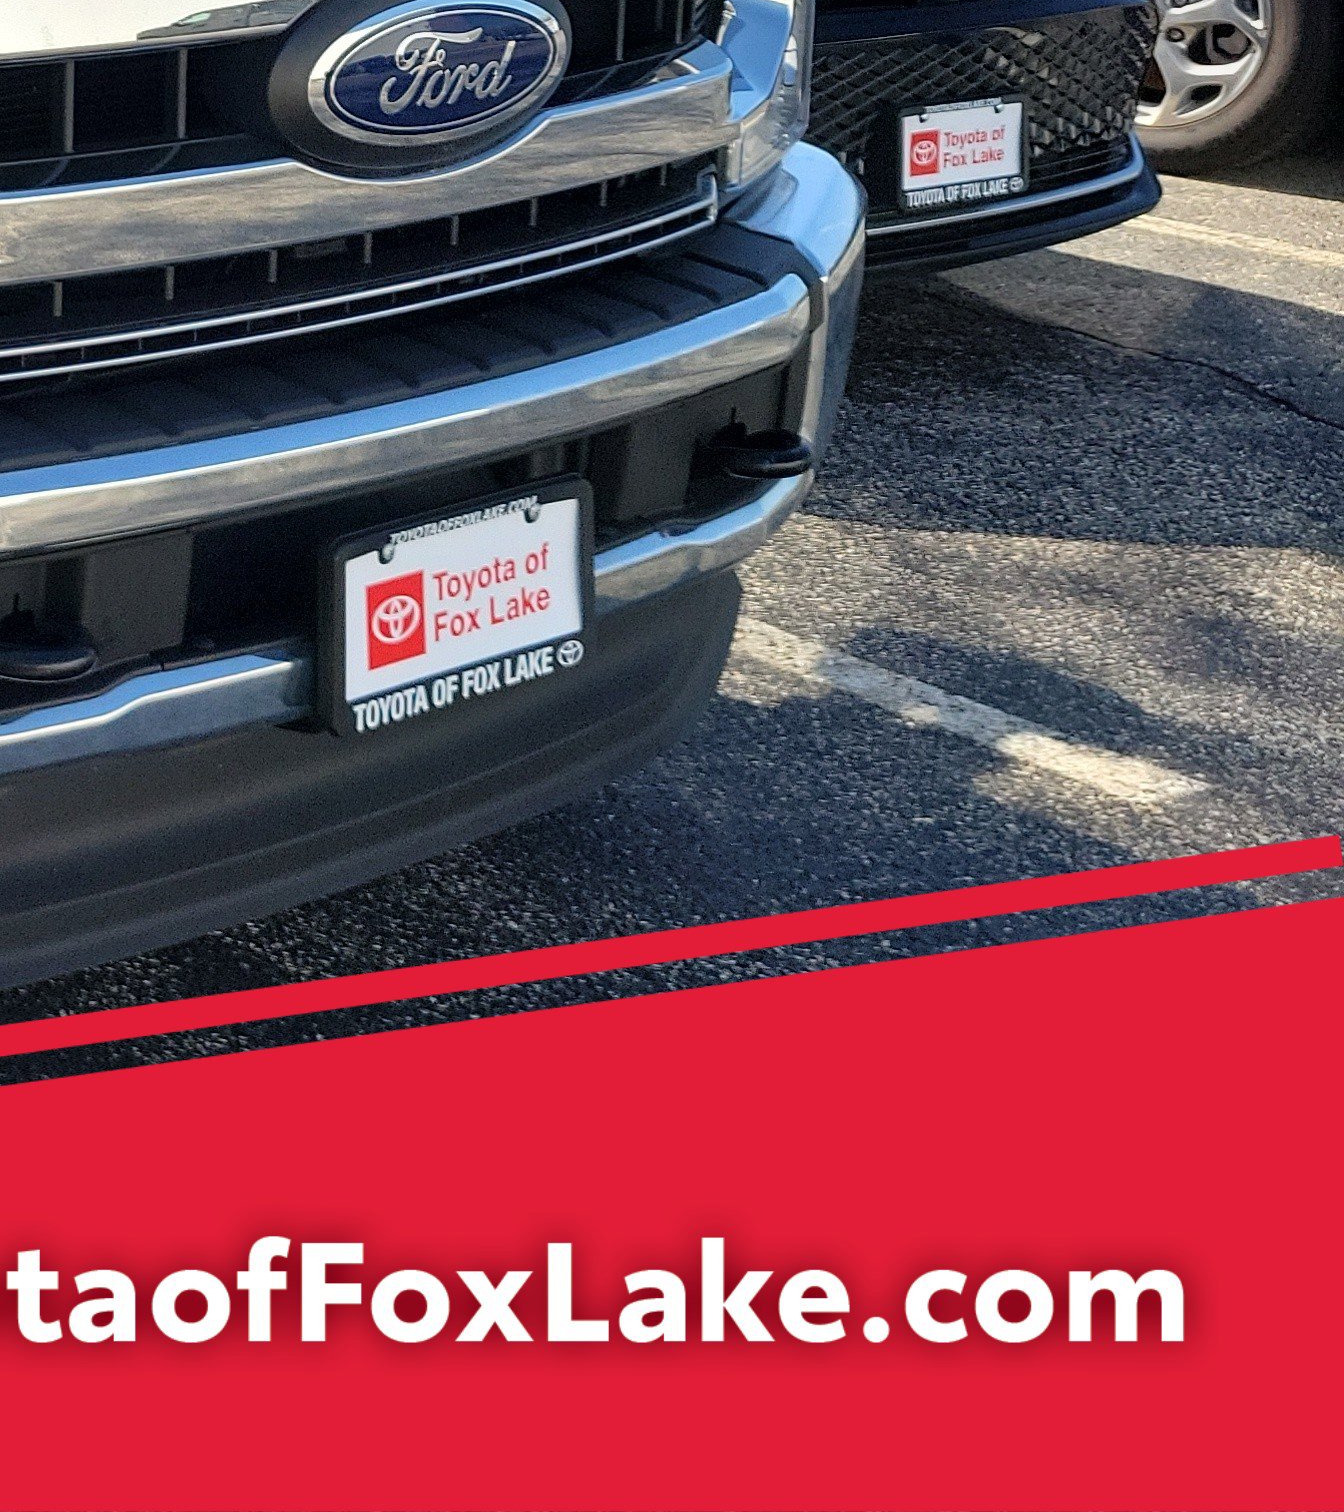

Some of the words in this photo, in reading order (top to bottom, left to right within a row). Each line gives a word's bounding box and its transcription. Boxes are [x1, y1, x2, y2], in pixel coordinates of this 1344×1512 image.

[378, 26, 517, 115] Ford
[943, 152, 967, 168] Fox
[972, 147, 1005, 164] Lake
[944, 129, 988, 149] Toyota
[991, 125, 1006, 141] of
[905, 186, 946, 207] TOYOTA
[945, 184, 960, 202] OF
[960, 181, 982, 200] FOX
[981, 177, 1009, 196] LAKE
[432, 557, 516, 603] Toyota
[525, 542, 550, 575] of
[433, 611, 481, 642] Fox
[489, 587, 551, 626] Lake
[351, 688, 430, 734] TOYOTA
[431, 672, 463, 709] OF
[462, 658, 503, 701] FOX
[503, 646, 556, 687] LAKE
